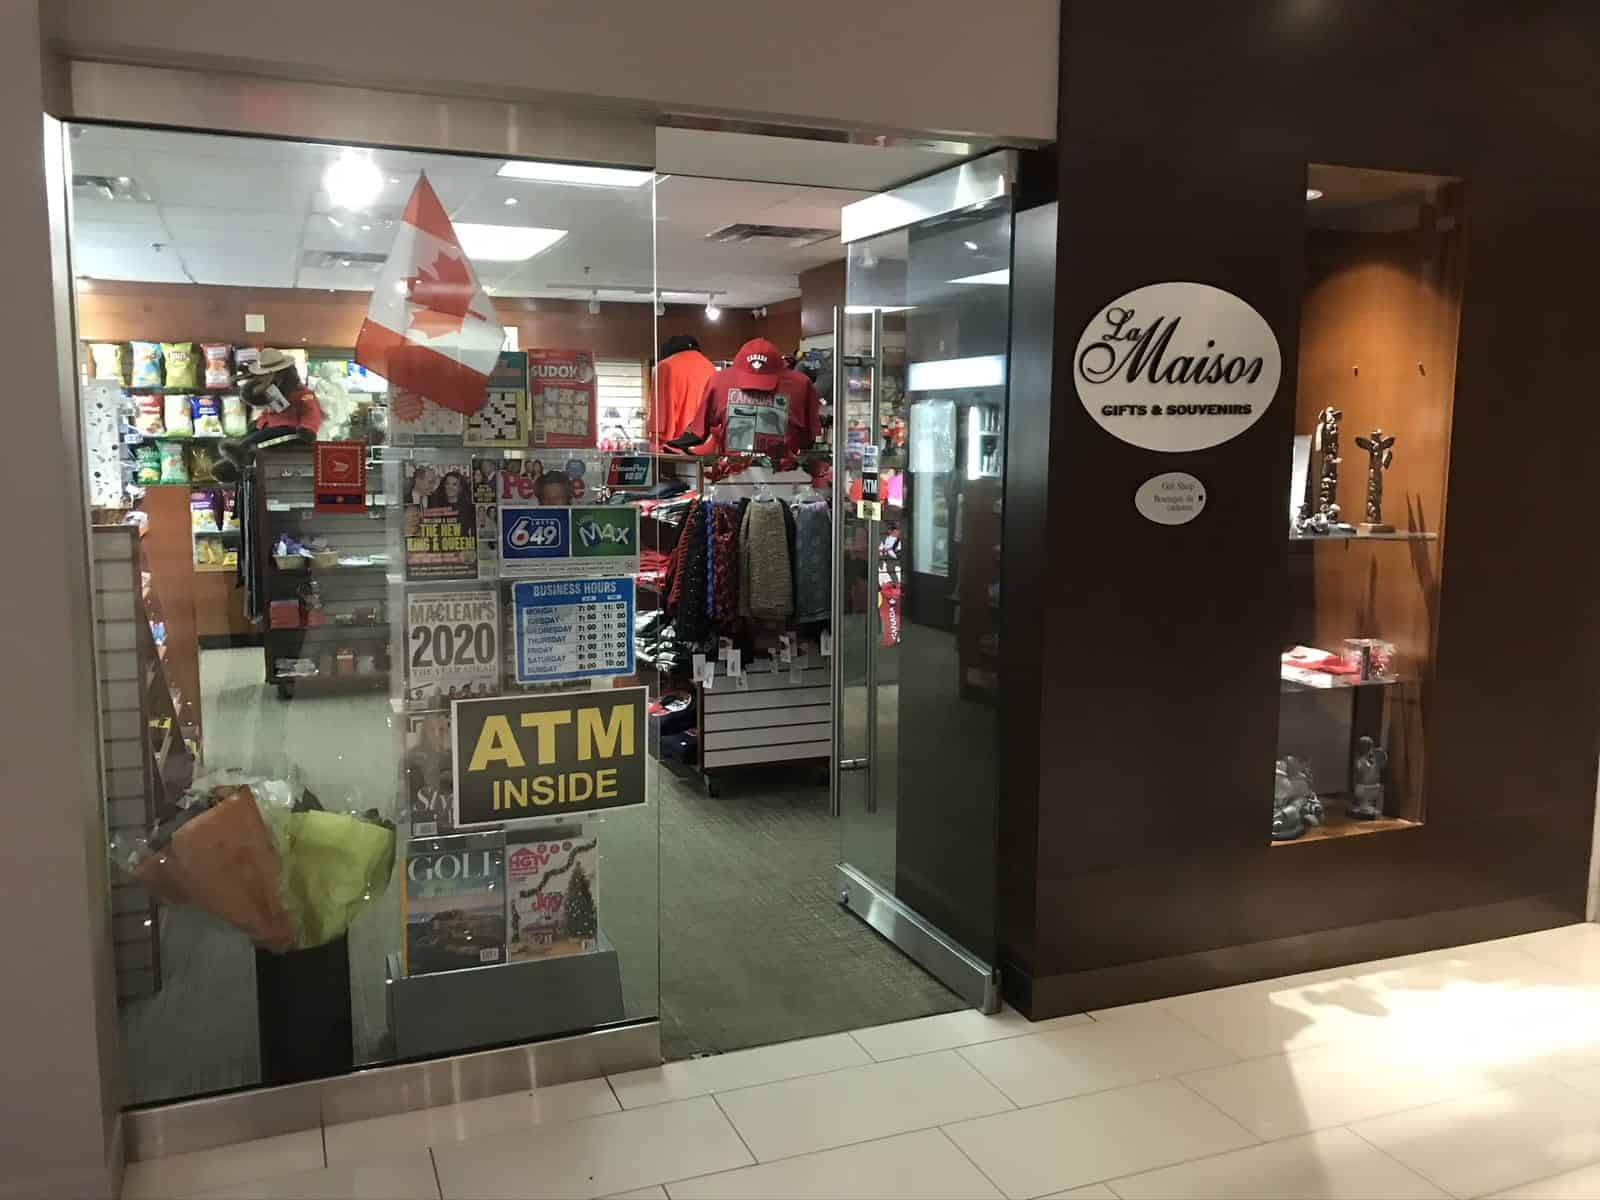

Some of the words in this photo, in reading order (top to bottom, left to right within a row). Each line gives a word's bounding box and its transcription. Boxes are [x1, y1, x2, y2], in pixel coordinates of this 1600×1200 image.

[1102, 307, 1143, 342] La
[1079, 316, 1264, 385] Maison
[531, 365, 577, 378] SUDOK
[1102, 404, 1147, 417] GIFTS
[1151, 405, 1163, 416] &
[1167, 404, 1253, 416] SOUVENIRS
[863, 478, 878, 495] ATM
[533, 583, 581, 597] BUSINESS
[583, 581, 617, 594] HOURS
[410, 602, 495, 625] MACLEAN'S
[412, 622, 496, 668] 2020
[467, 703, 635, 772] ATM
[492, 768, 619, 810] INSIDE
